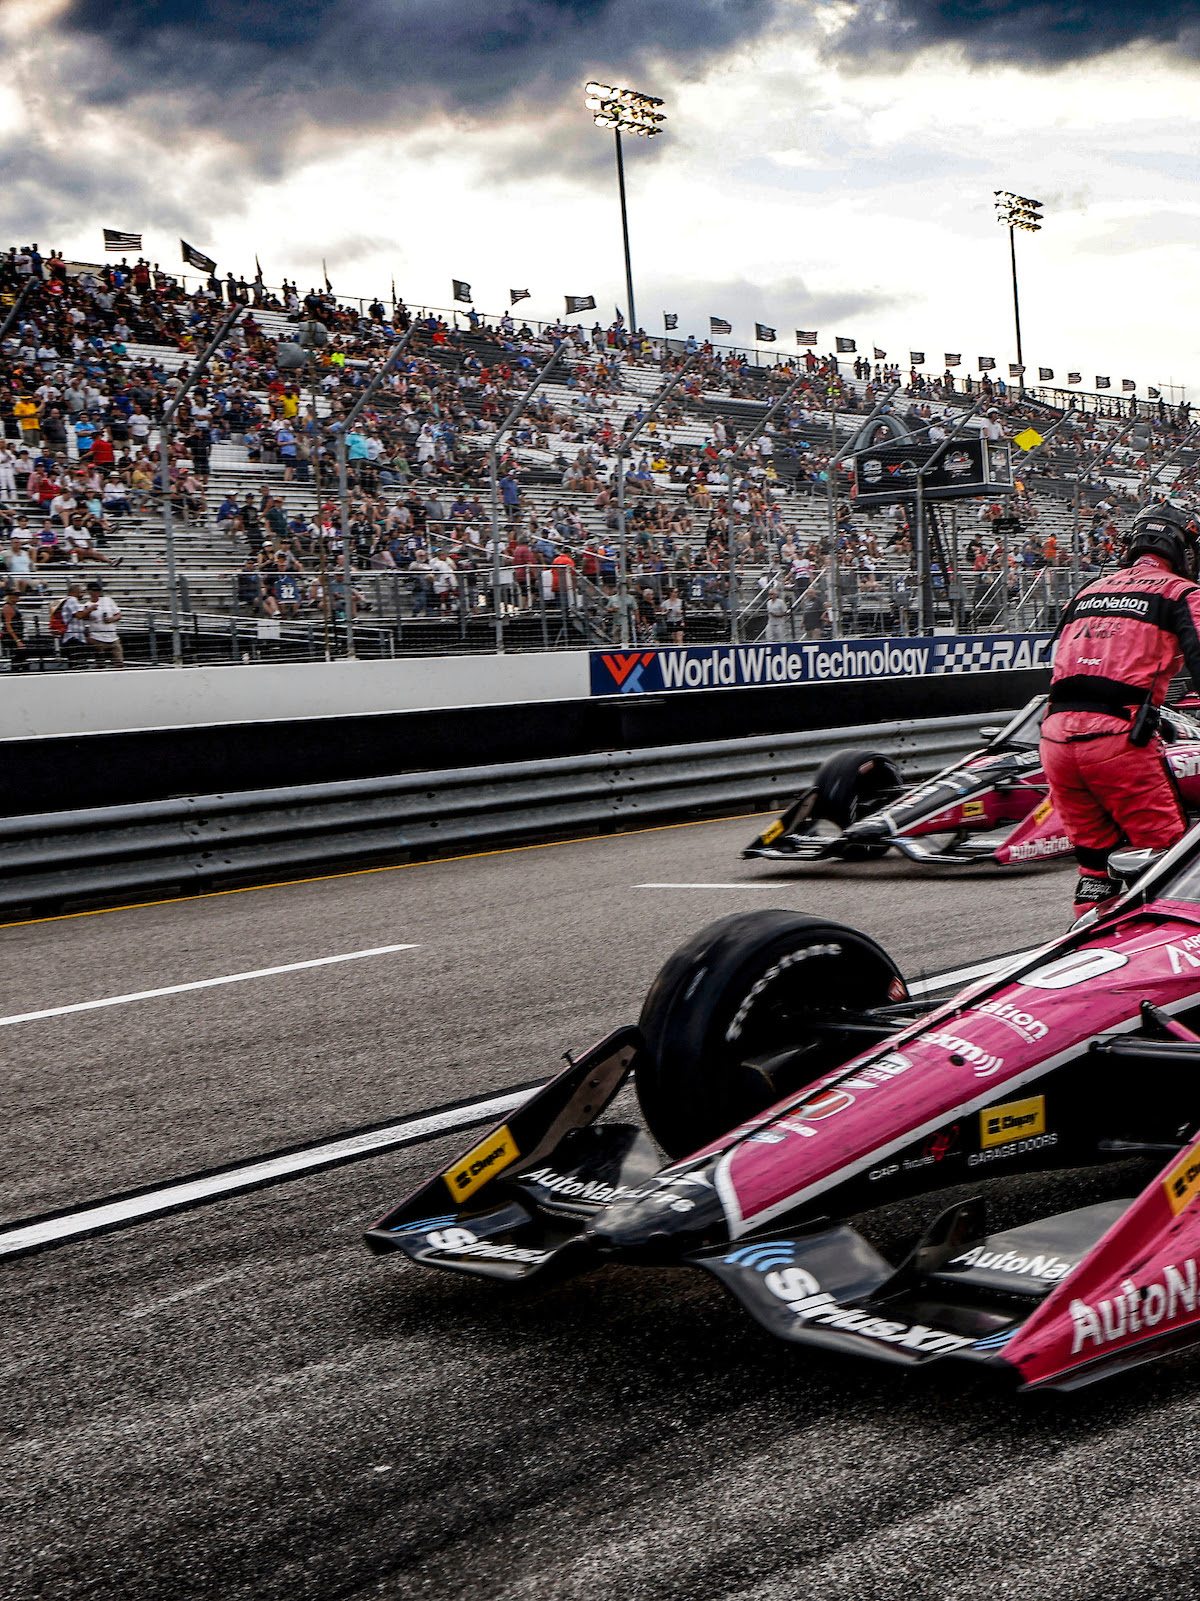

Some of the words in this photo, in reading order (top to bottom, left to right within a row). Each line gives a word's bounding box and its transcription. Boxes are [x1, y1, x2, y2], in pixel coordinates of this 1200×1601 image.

[658, 646, 740, 688] World
[739, 641, 802, 683] Wide
[801, 641, 930, 679] Technology
[967, 1140, 1018, 1168] GARAGE
